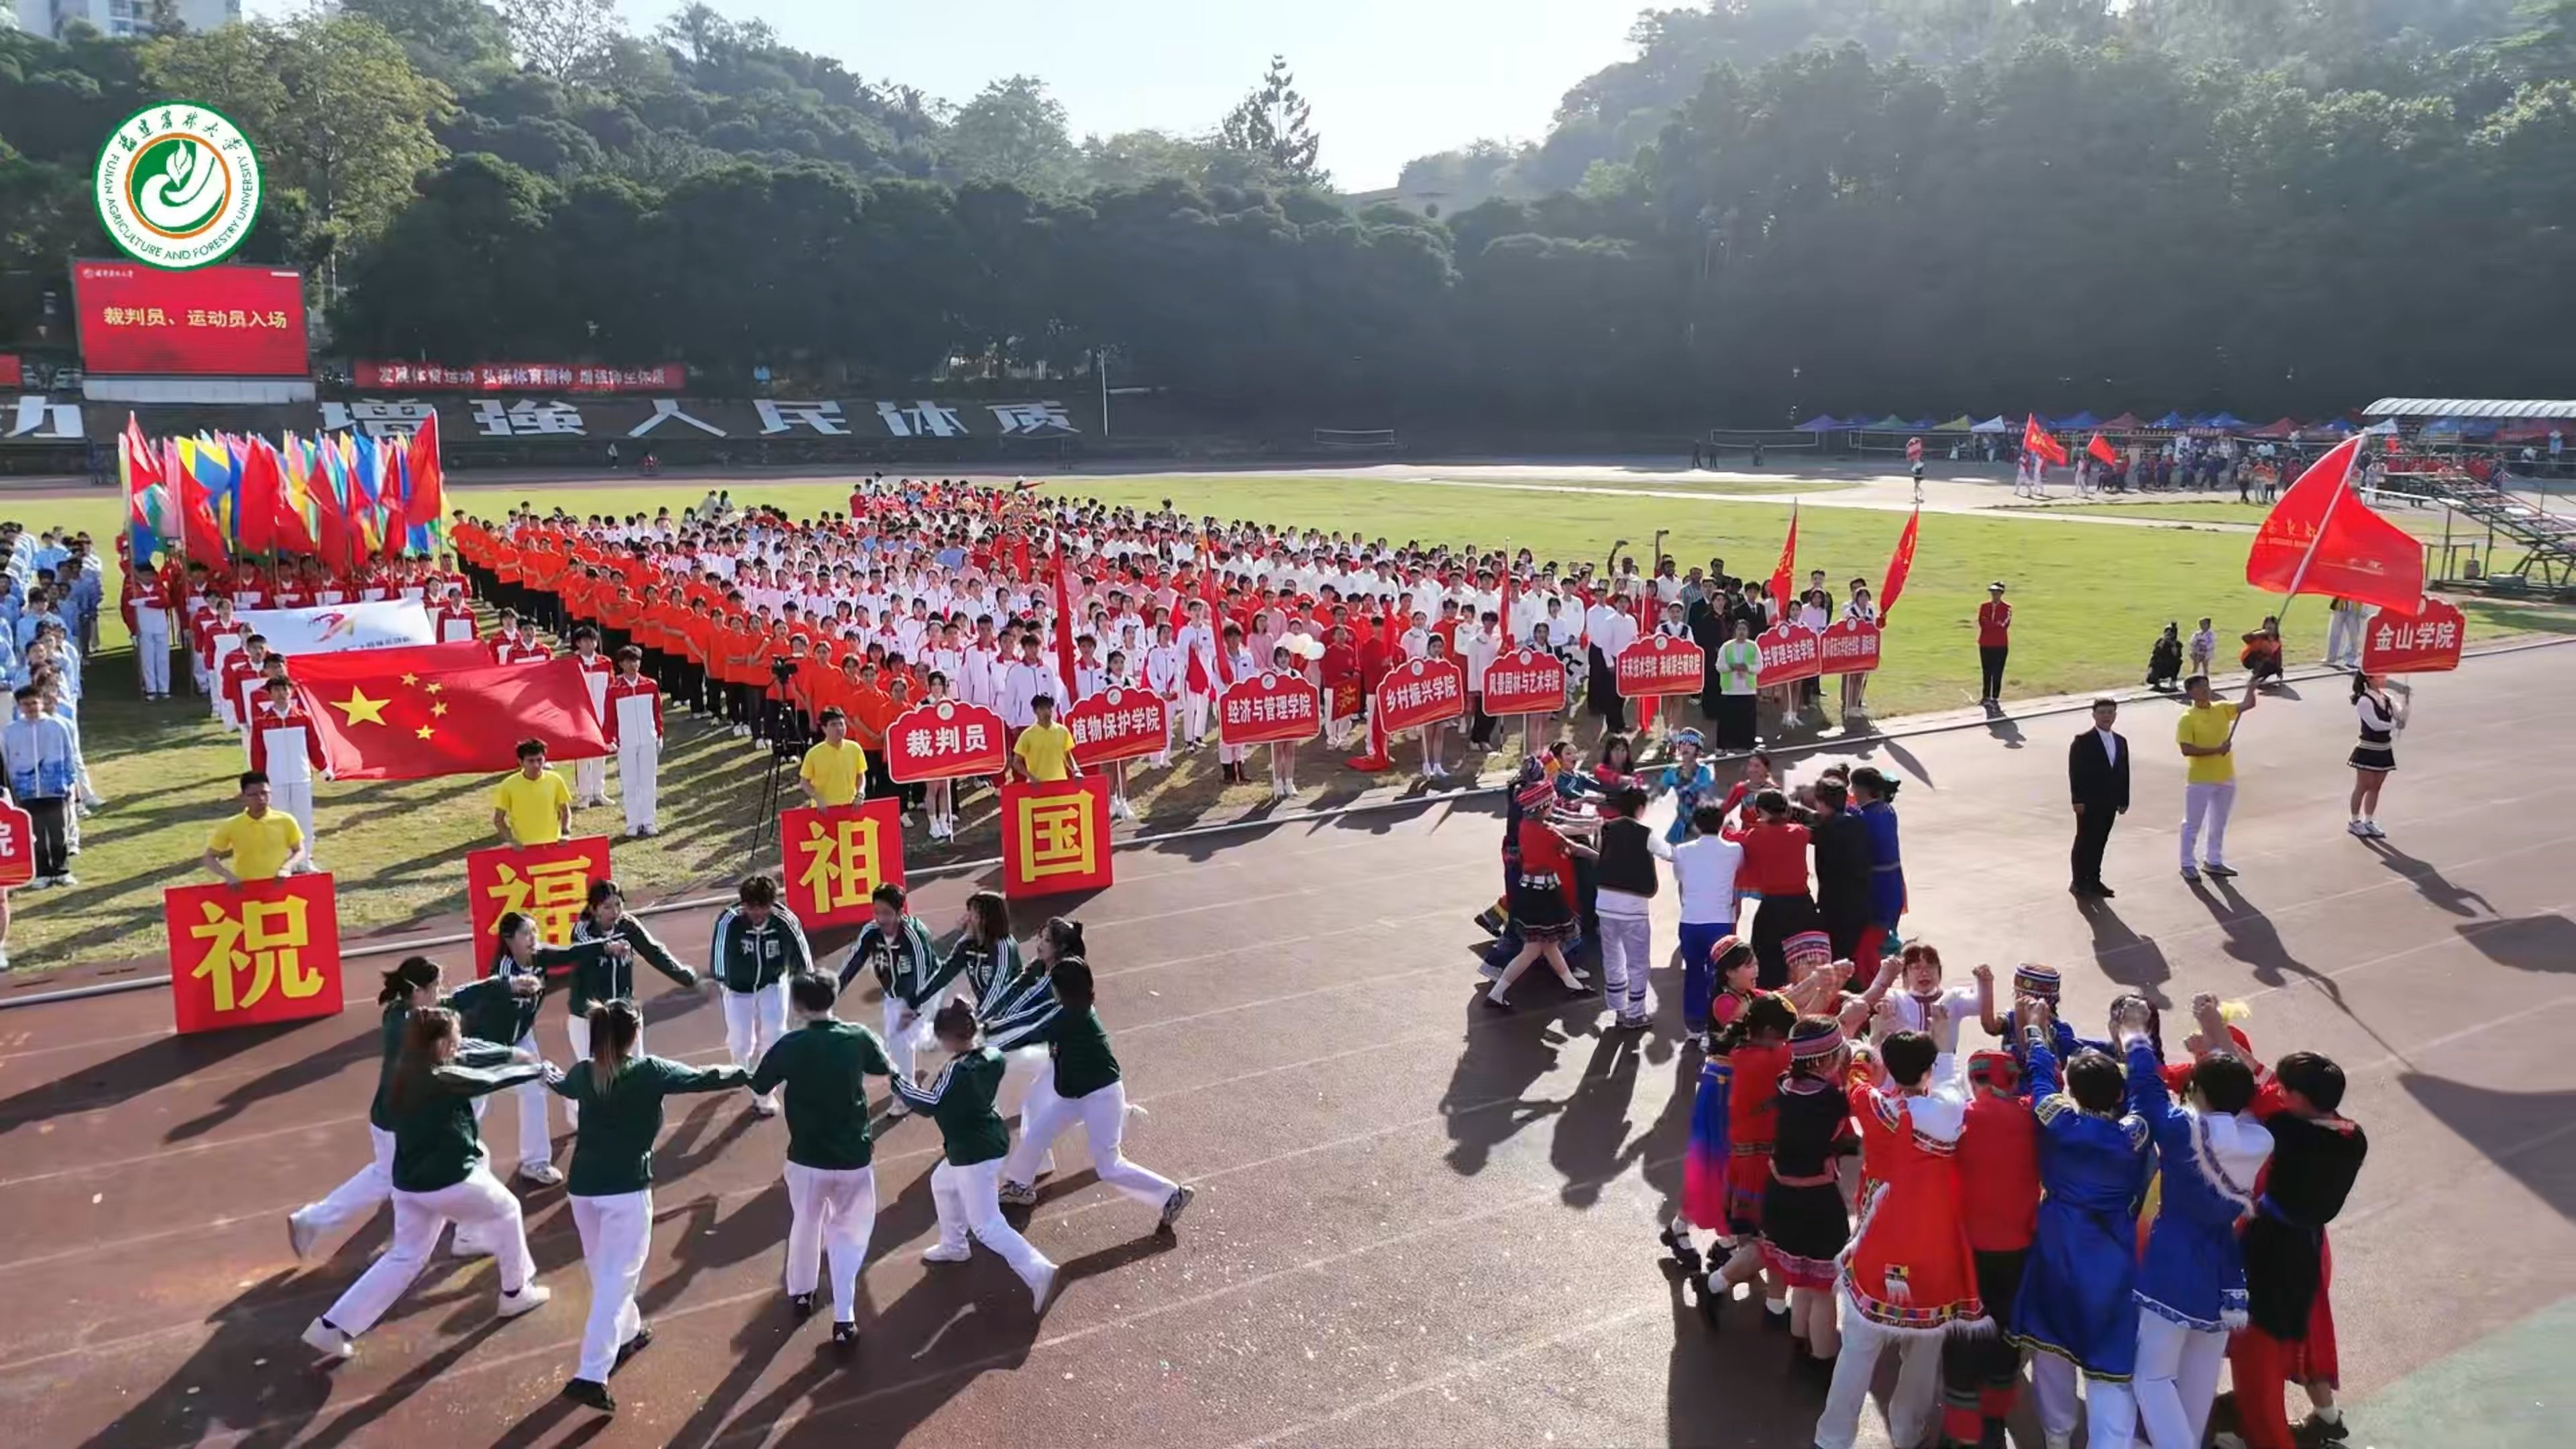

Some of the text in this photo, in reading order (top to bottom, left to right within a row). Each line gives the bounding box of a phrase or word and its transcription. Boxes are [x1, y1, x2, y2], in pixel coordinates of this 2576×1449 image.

[103, 307, 287, 329] 裁判员、运动员入场
[1762, 638, 1815, 669] 共管理与法学院
[2373, 620, 2456, 651] 金山学院
[1385, 672, 1457, 714] 乡村振兴学院
[1488, 668, 1560, 697] 风景园林与艺术学院
[1072, 705, 1161, 745] 植物保护学院
[1227, 692, 1312, 724] 经济与管理学院
[906, 724, 988, 758] 裁判员
[1018, 789, 1097, 883] 国
[799, 816, 888, 914] 祖
[487, 855, 592, 947] 福
[191, 894, 325, 1012] 祝
